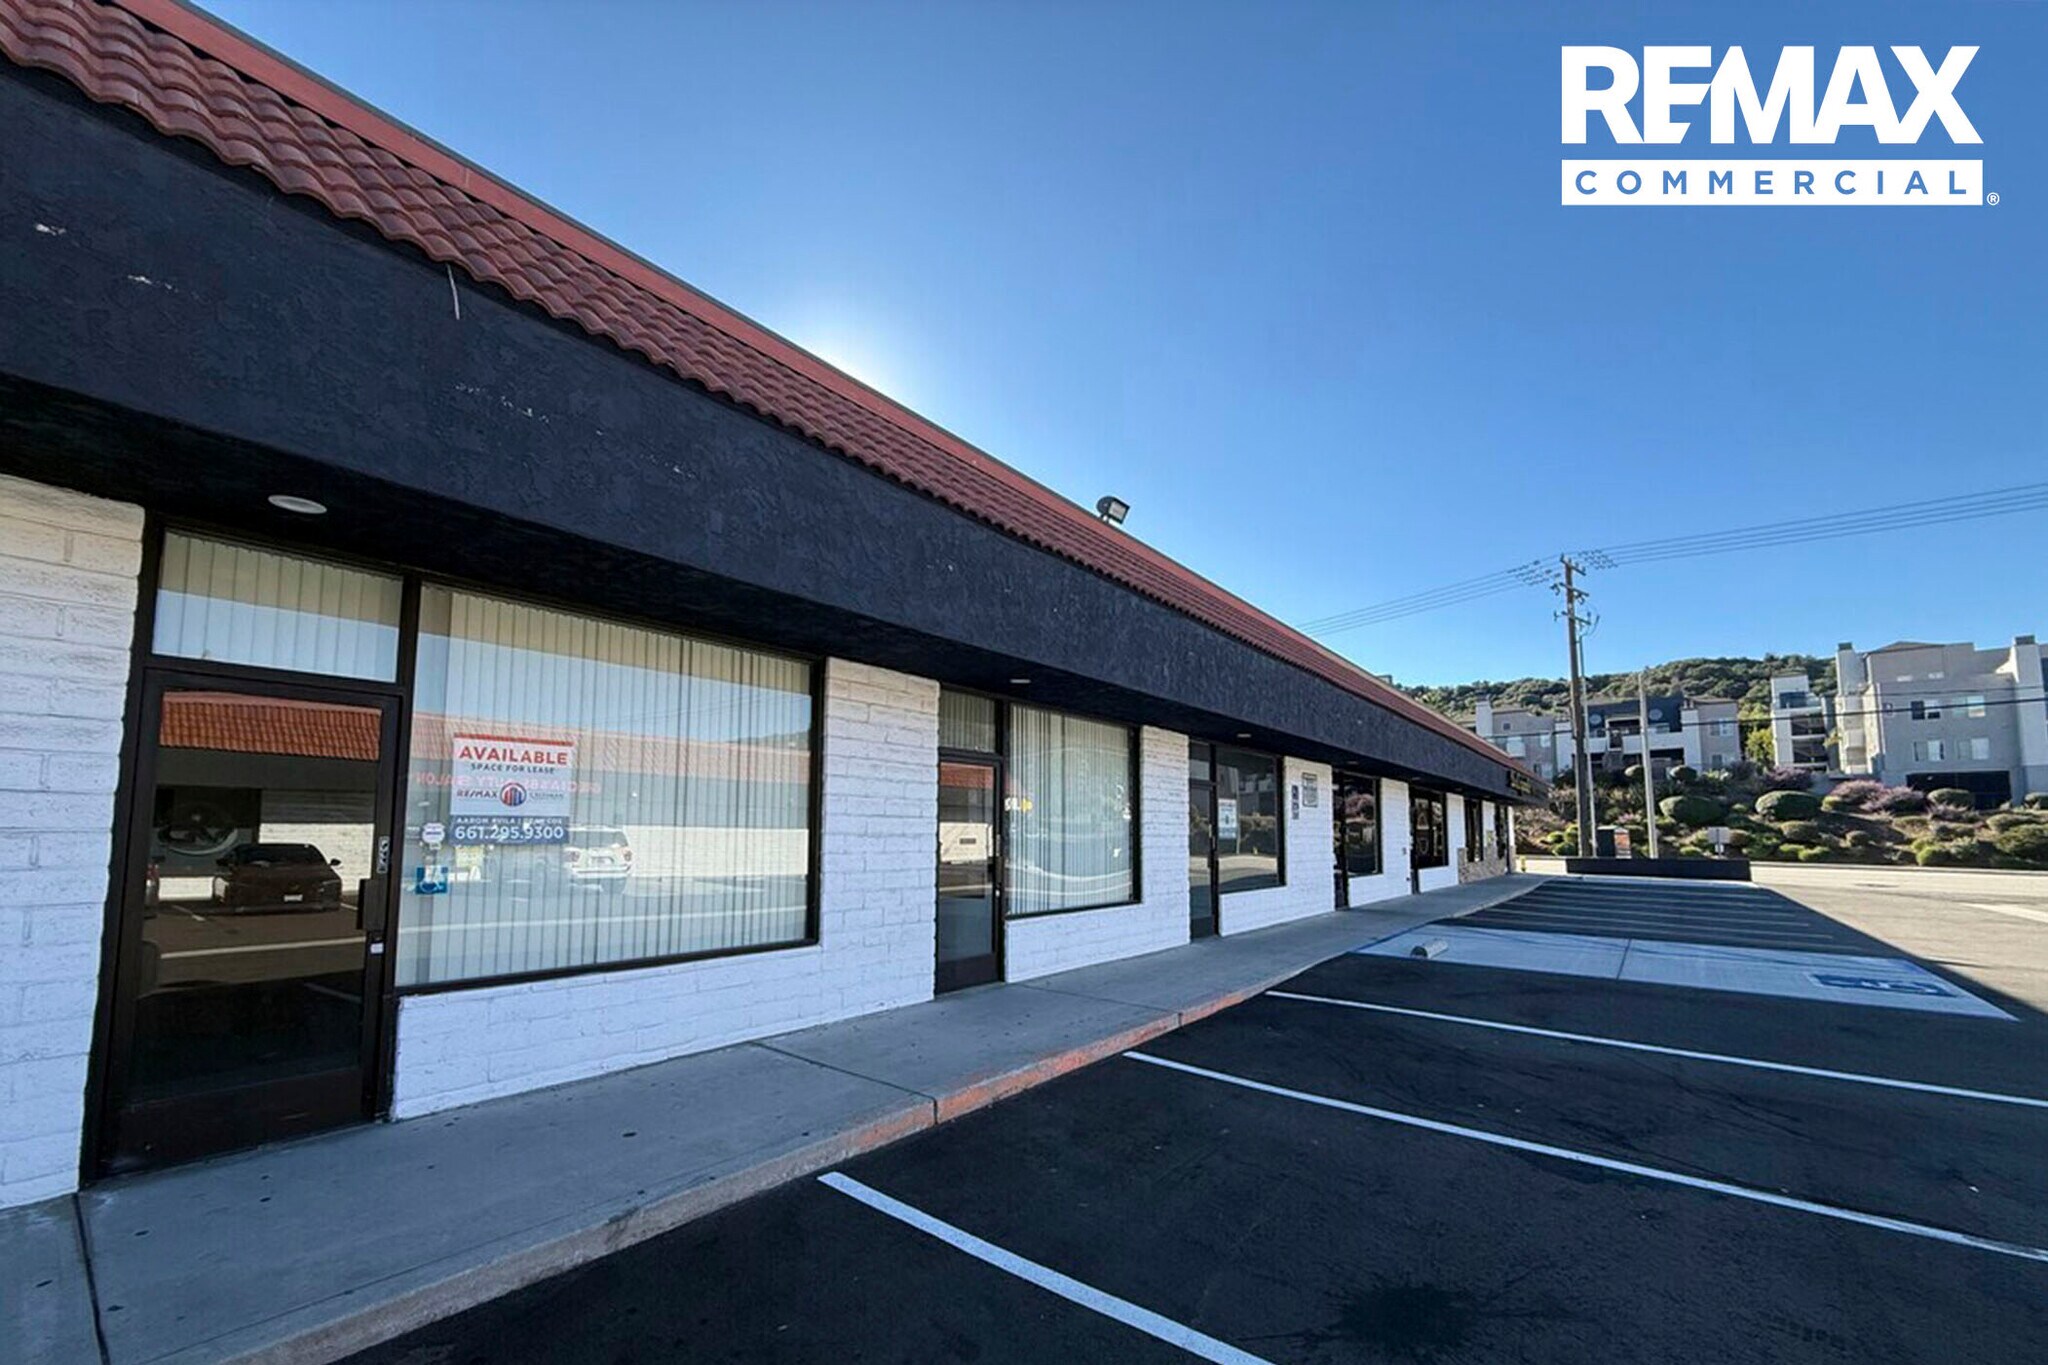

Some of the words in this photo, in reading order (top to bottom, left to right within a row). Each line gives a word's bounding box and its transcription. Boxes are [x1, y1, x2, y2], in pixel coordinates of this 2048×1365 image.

[459, 745, 568, 765] AVAILABLE
[471, 762, 502, 772] SPACE
[505, 764, 525, 773] FOR
[527, 765, 555, 774] LEASE
[455, 825, 564, 840] 661.295.9300
